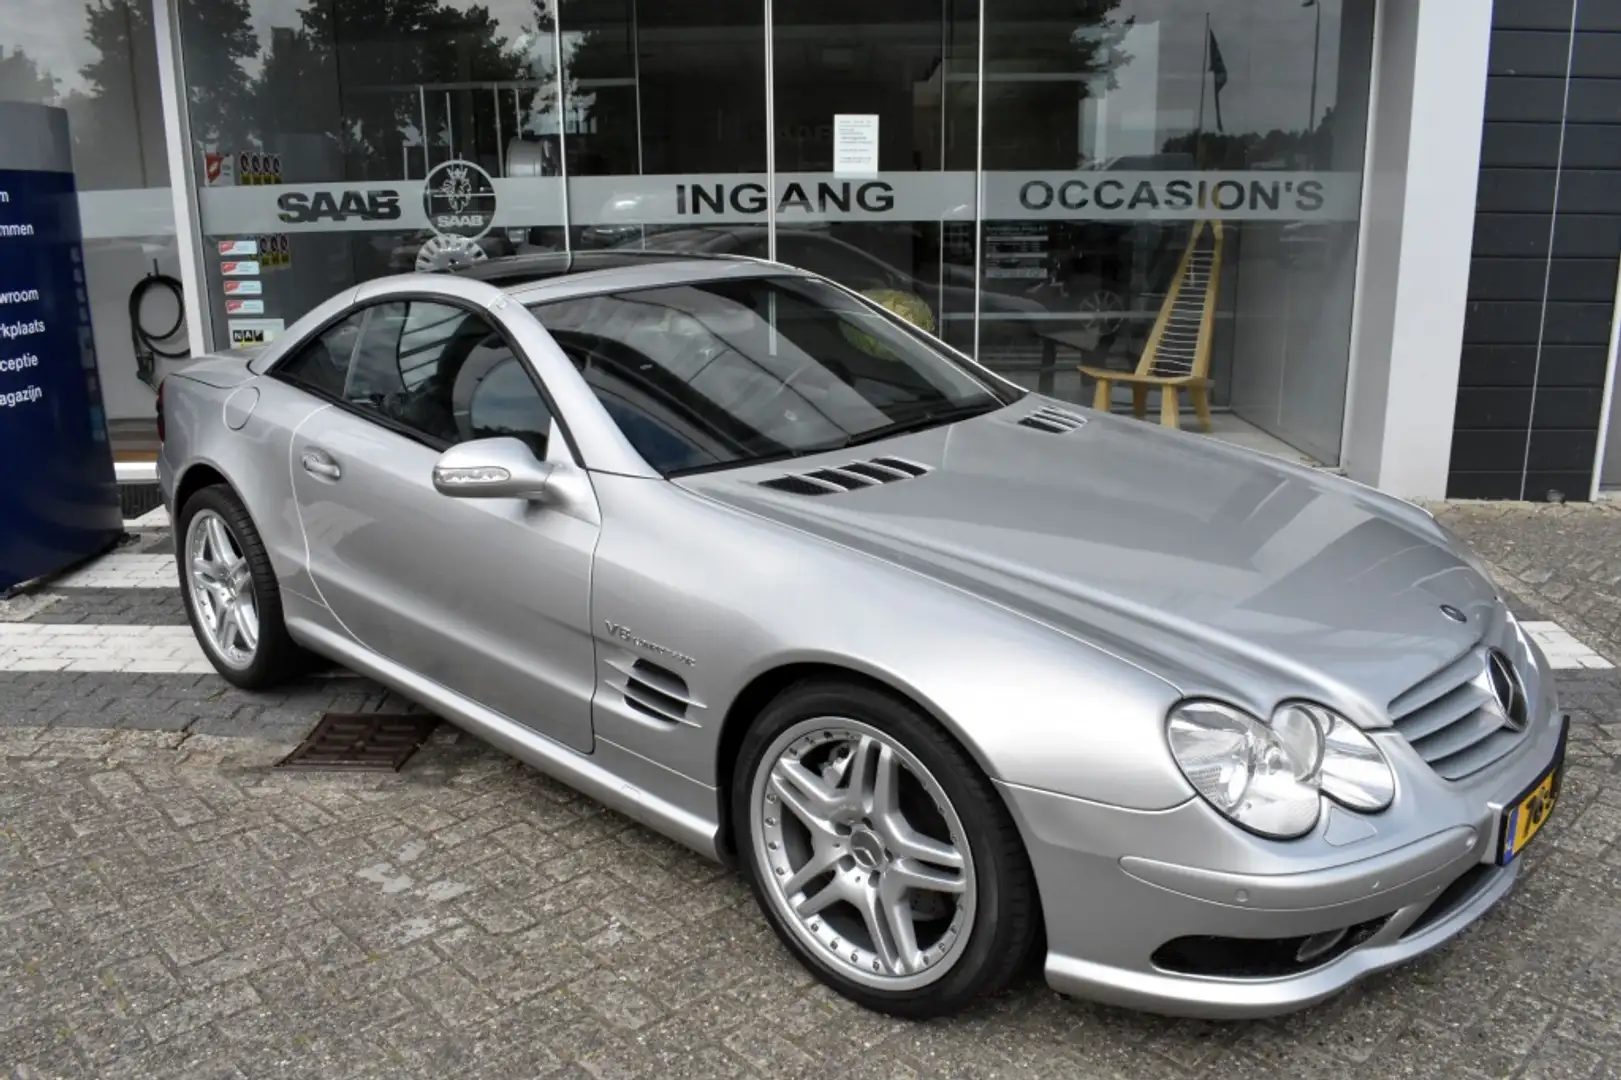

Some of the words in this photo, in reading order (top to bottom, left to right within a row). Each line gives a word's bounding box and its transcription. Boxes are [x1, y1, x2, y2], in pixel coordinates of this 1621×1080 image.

[277, 190, 402, 223] SAAB
[676, 181, 894, 214] INGANG
[1018, 180, 1325, 211] OCCASION'S
[437, 214, 484, 228] SAAB
[0, 352, 38, 372] ceptie
[0, 384, 42, 407] agazijn
